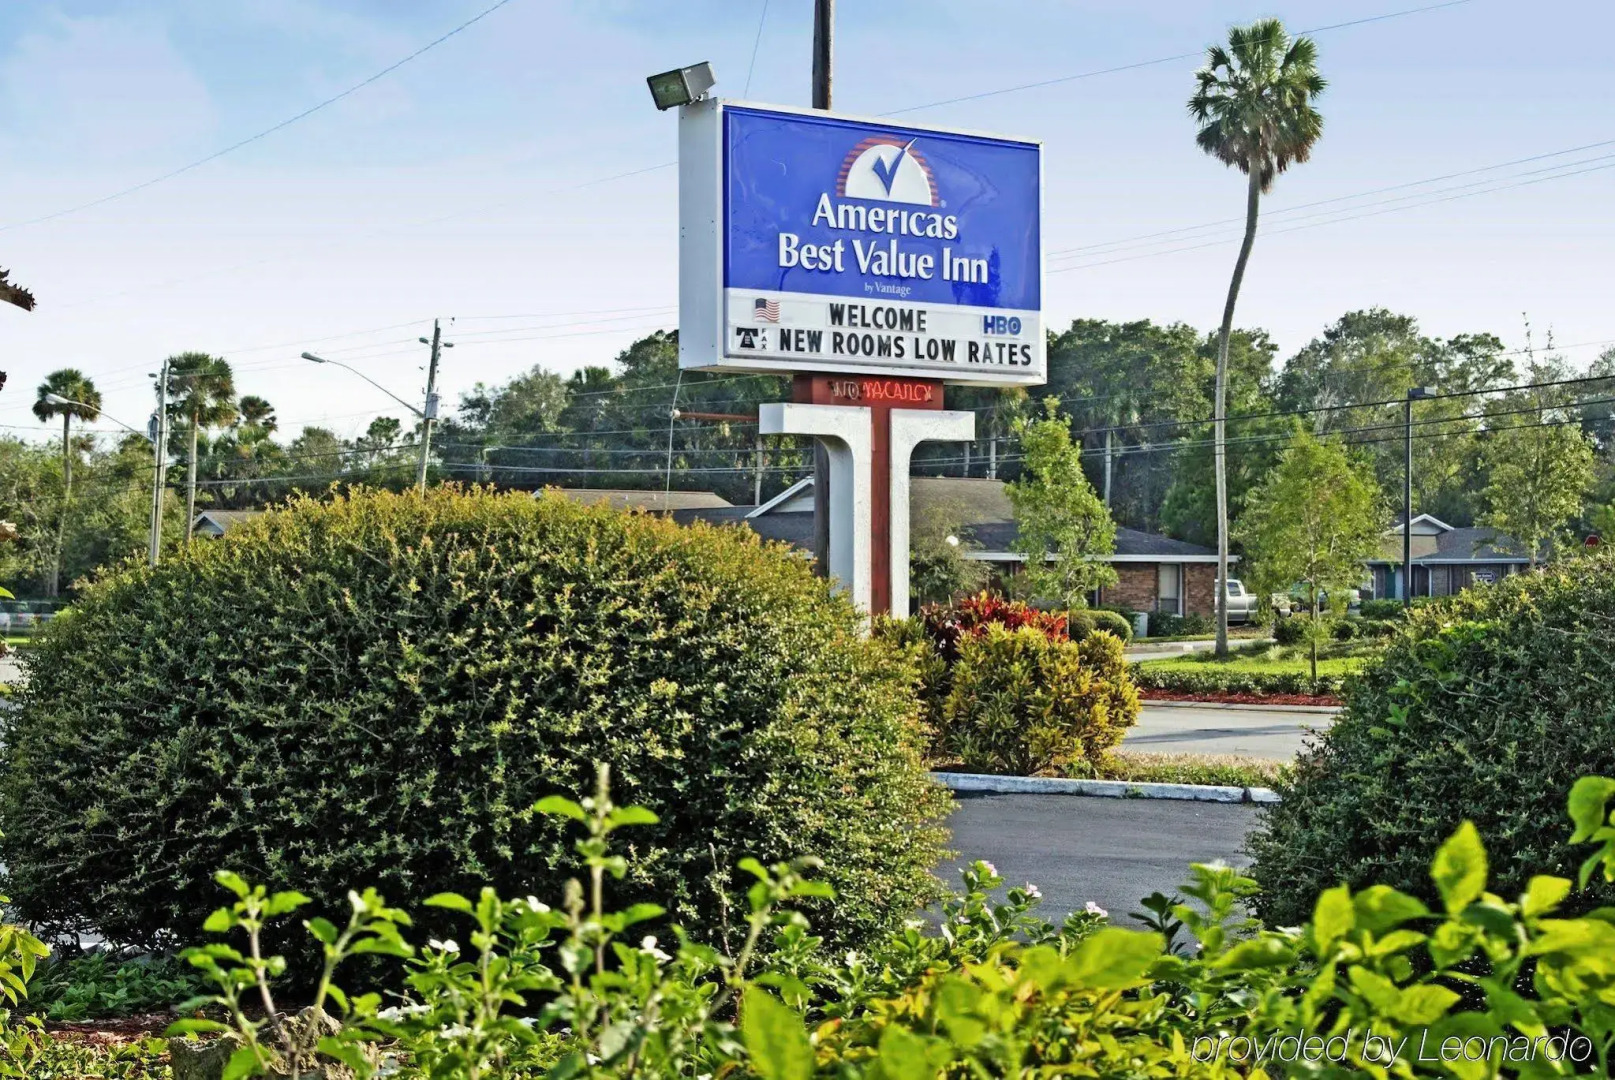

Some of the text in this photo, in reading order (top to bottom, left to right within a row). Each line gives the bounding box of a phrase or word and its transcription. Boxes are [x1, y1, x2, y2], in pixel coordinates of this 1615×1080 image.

[812, 192, 958, 240] Americas
[778, 232, 988, 284] Best Value Inn
[864, 282, 911, 297] by Vantage
[829, 303, 927, 332] WELCOME
[984, 316, 1022, 335] HBO
[779, 328, 1032, 366] NEW ROOMS LOW RATES
[863, 380, 932, 401] VACANCY
